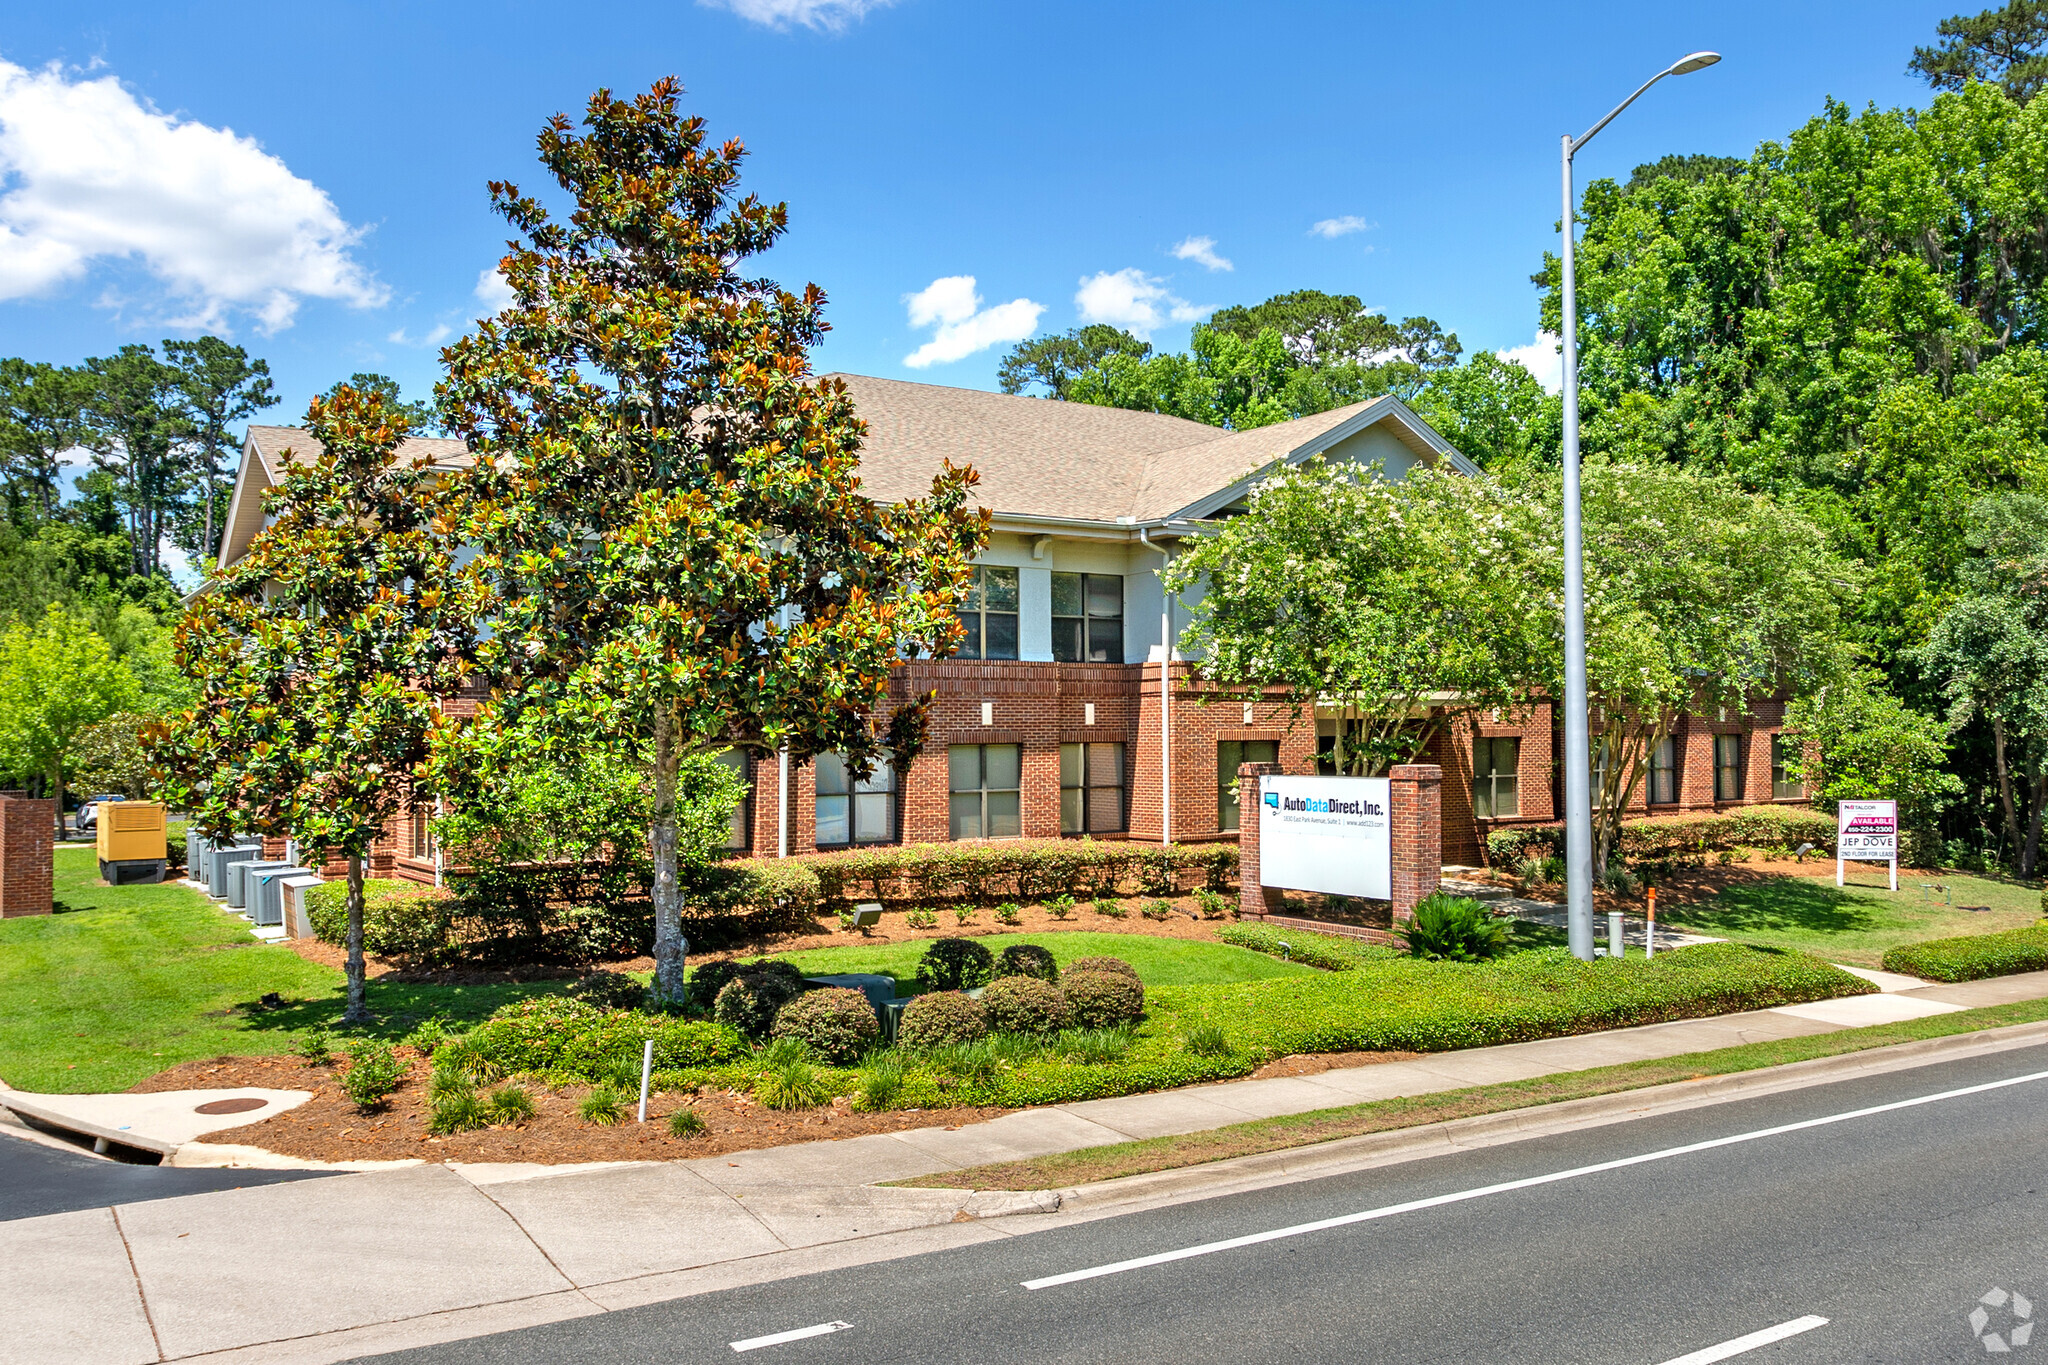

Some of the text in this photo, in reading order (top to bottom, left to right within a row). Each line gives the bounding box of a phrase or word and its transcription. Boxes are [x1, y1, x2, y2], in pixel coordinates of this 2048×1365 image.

[1364, 799, 1383, 816] Inc.
[1842, 837, 1893, 847] JEP DOVE
